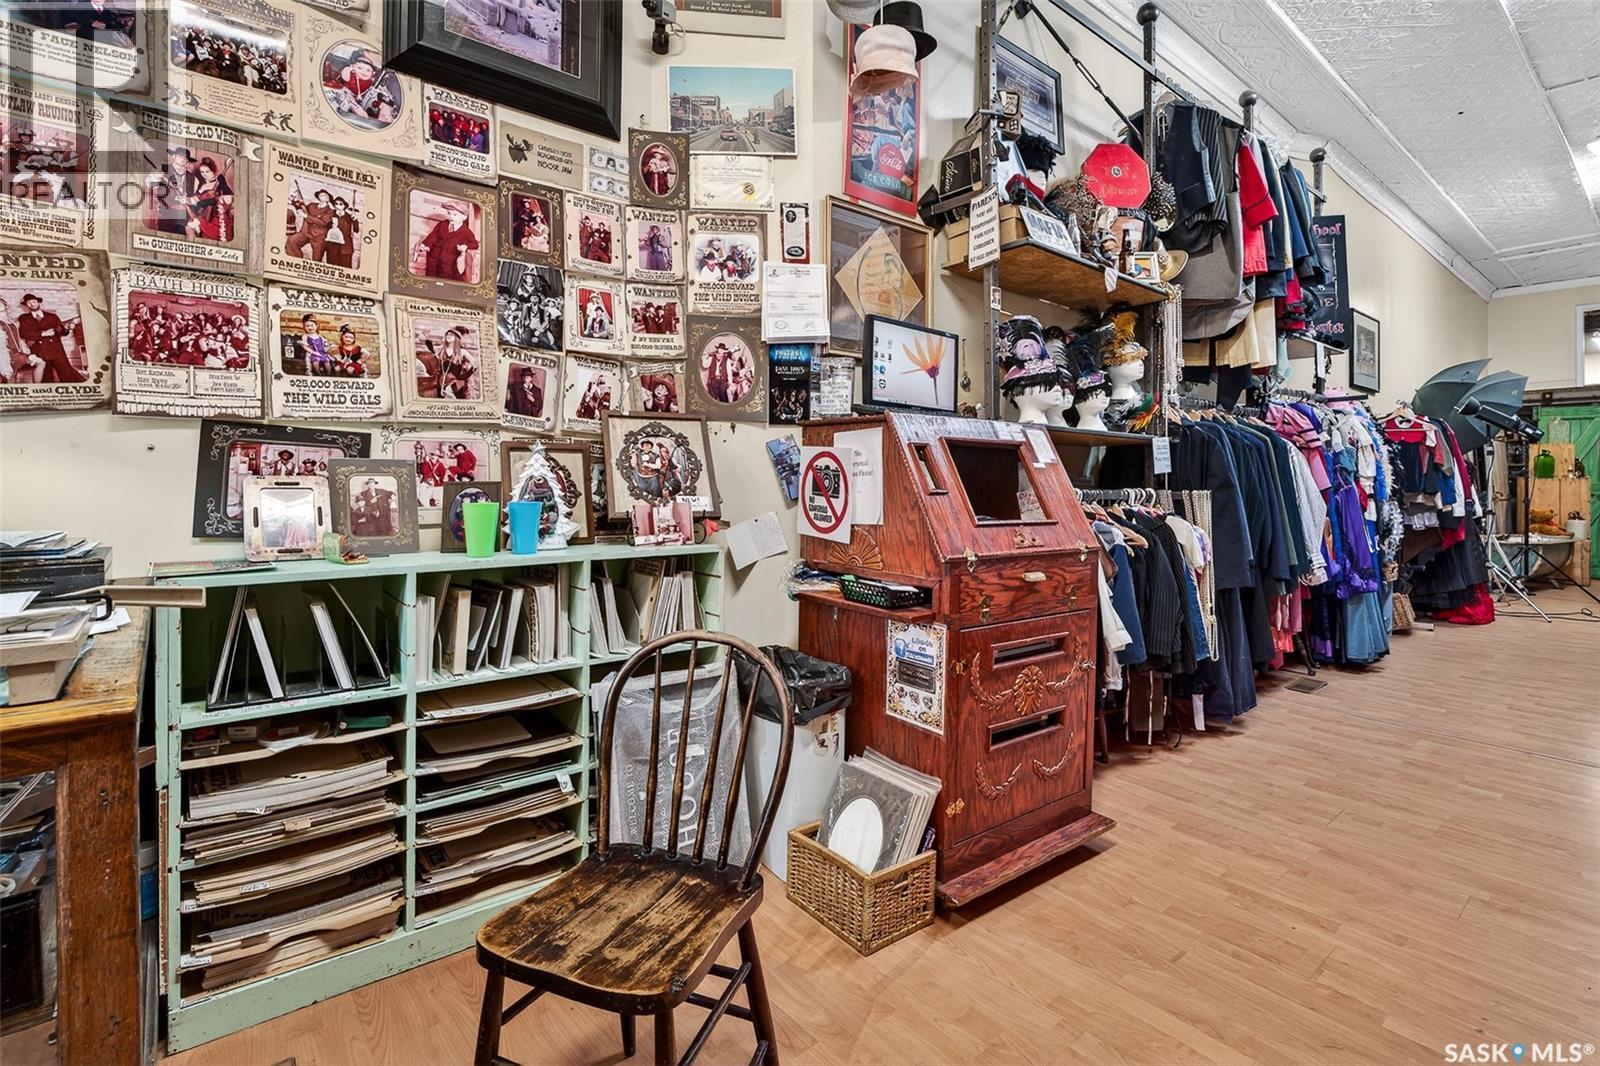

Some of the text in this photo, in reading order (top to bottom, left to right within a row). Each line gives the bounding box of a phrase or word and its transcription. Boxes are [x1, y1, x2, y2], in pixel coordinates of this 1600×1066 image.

[82, 43, 137, 62] NELSON
[38, 103, 81, 124] REUNION
[197, 127, 213, 138] OLD
[215, 128, 240, 146] WEST
[278, 151, 320, 171] WANTED
[322, 162, 334, 174] BY
[336, 166, 355, 180] THE
[972, 191, 998, 211] PARENTS
[631, 209, 678, 224] WANTED
[696, 216, 758, 228] WANTED
[151, 239, 206, 256] GUNFIGHTER
[31, 270, 74, 280] ALIVE
[271, 258, 336, 278] DANGEROUS
[338, 271, 372, 284] DAMES
[135, 274, 183, 291] BATH
[192, 282, 245, 298] HOUSE
[632, 287, 677, 298] WANTED
[281, 288, 376, 307] WANTED
[286, 299, 373, 314] DEAD OR ALIVE
[711, 293, 732, 302] WILD
[502, 347, 556, 368] WANTED
[32, 387, 53, 395] and
[55, 385, 102, 395] CLYDE
[290, 379, 375, 391] $25,000 REWARD
[283, 392, 381, 406] THE WILD GALS
[624, 763, 640, 836] WELCOME TO
